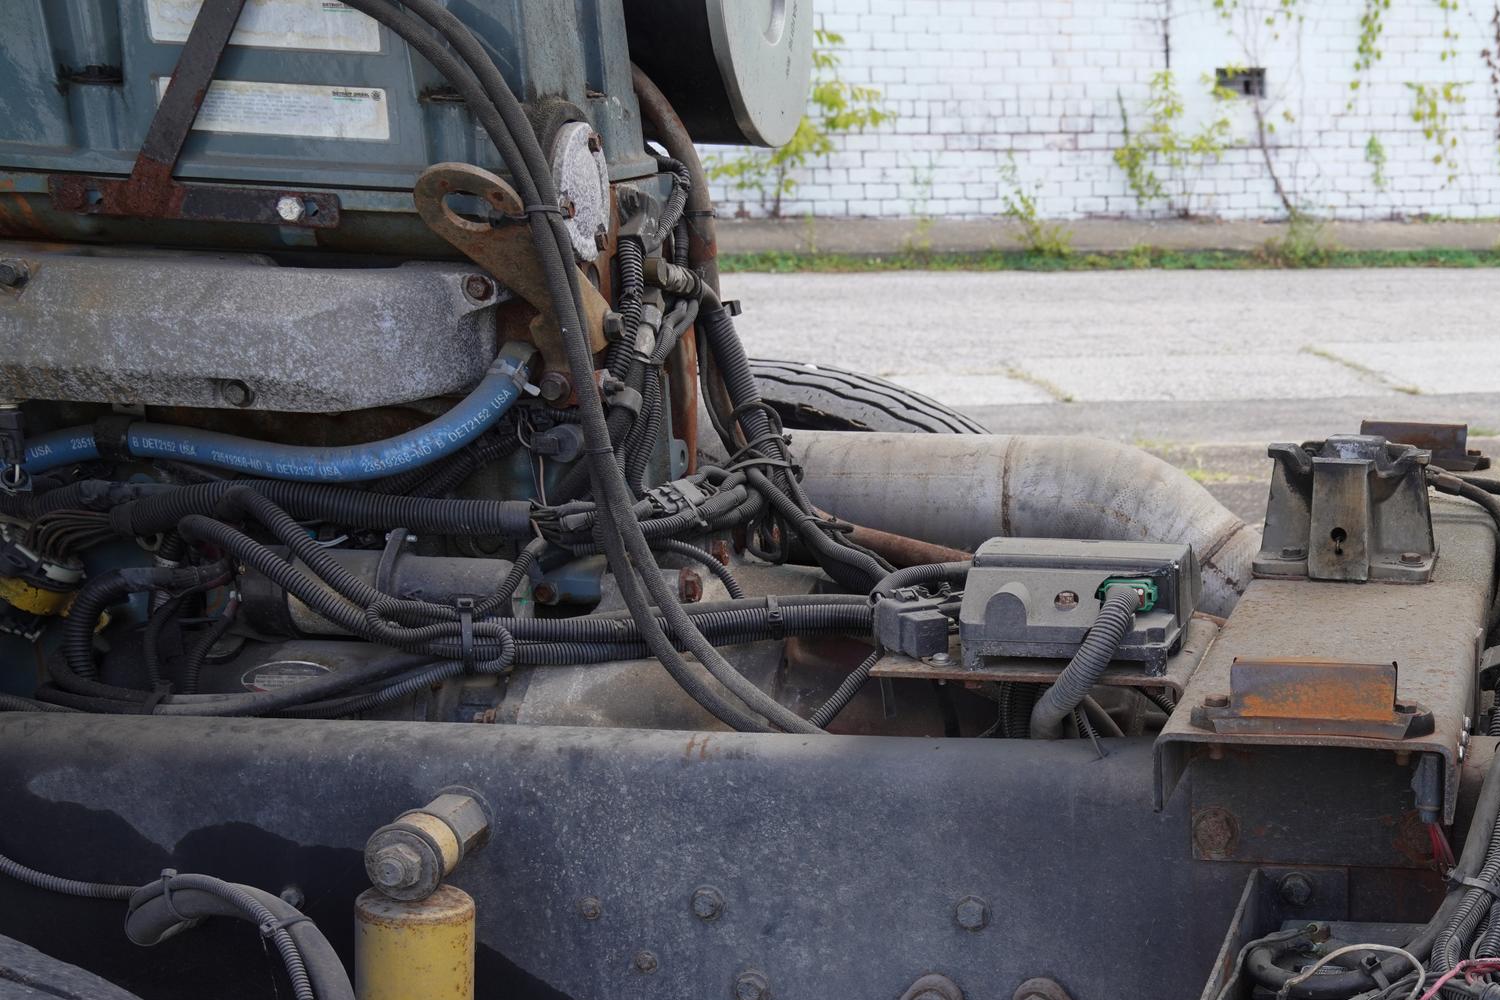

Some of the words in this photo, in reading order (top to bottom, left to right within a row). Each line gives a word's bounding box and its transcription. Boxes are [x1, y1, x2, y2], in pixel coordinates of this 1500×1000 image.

[447, 409, 492, 442] DET2152
[491, 388, 512, 410] USA
[30, 446, 52, 459] USA
[142, 437, 176, 453] DET2152
[179, 441, 197, 457] USA
[319, 463, 343, 477] USA
